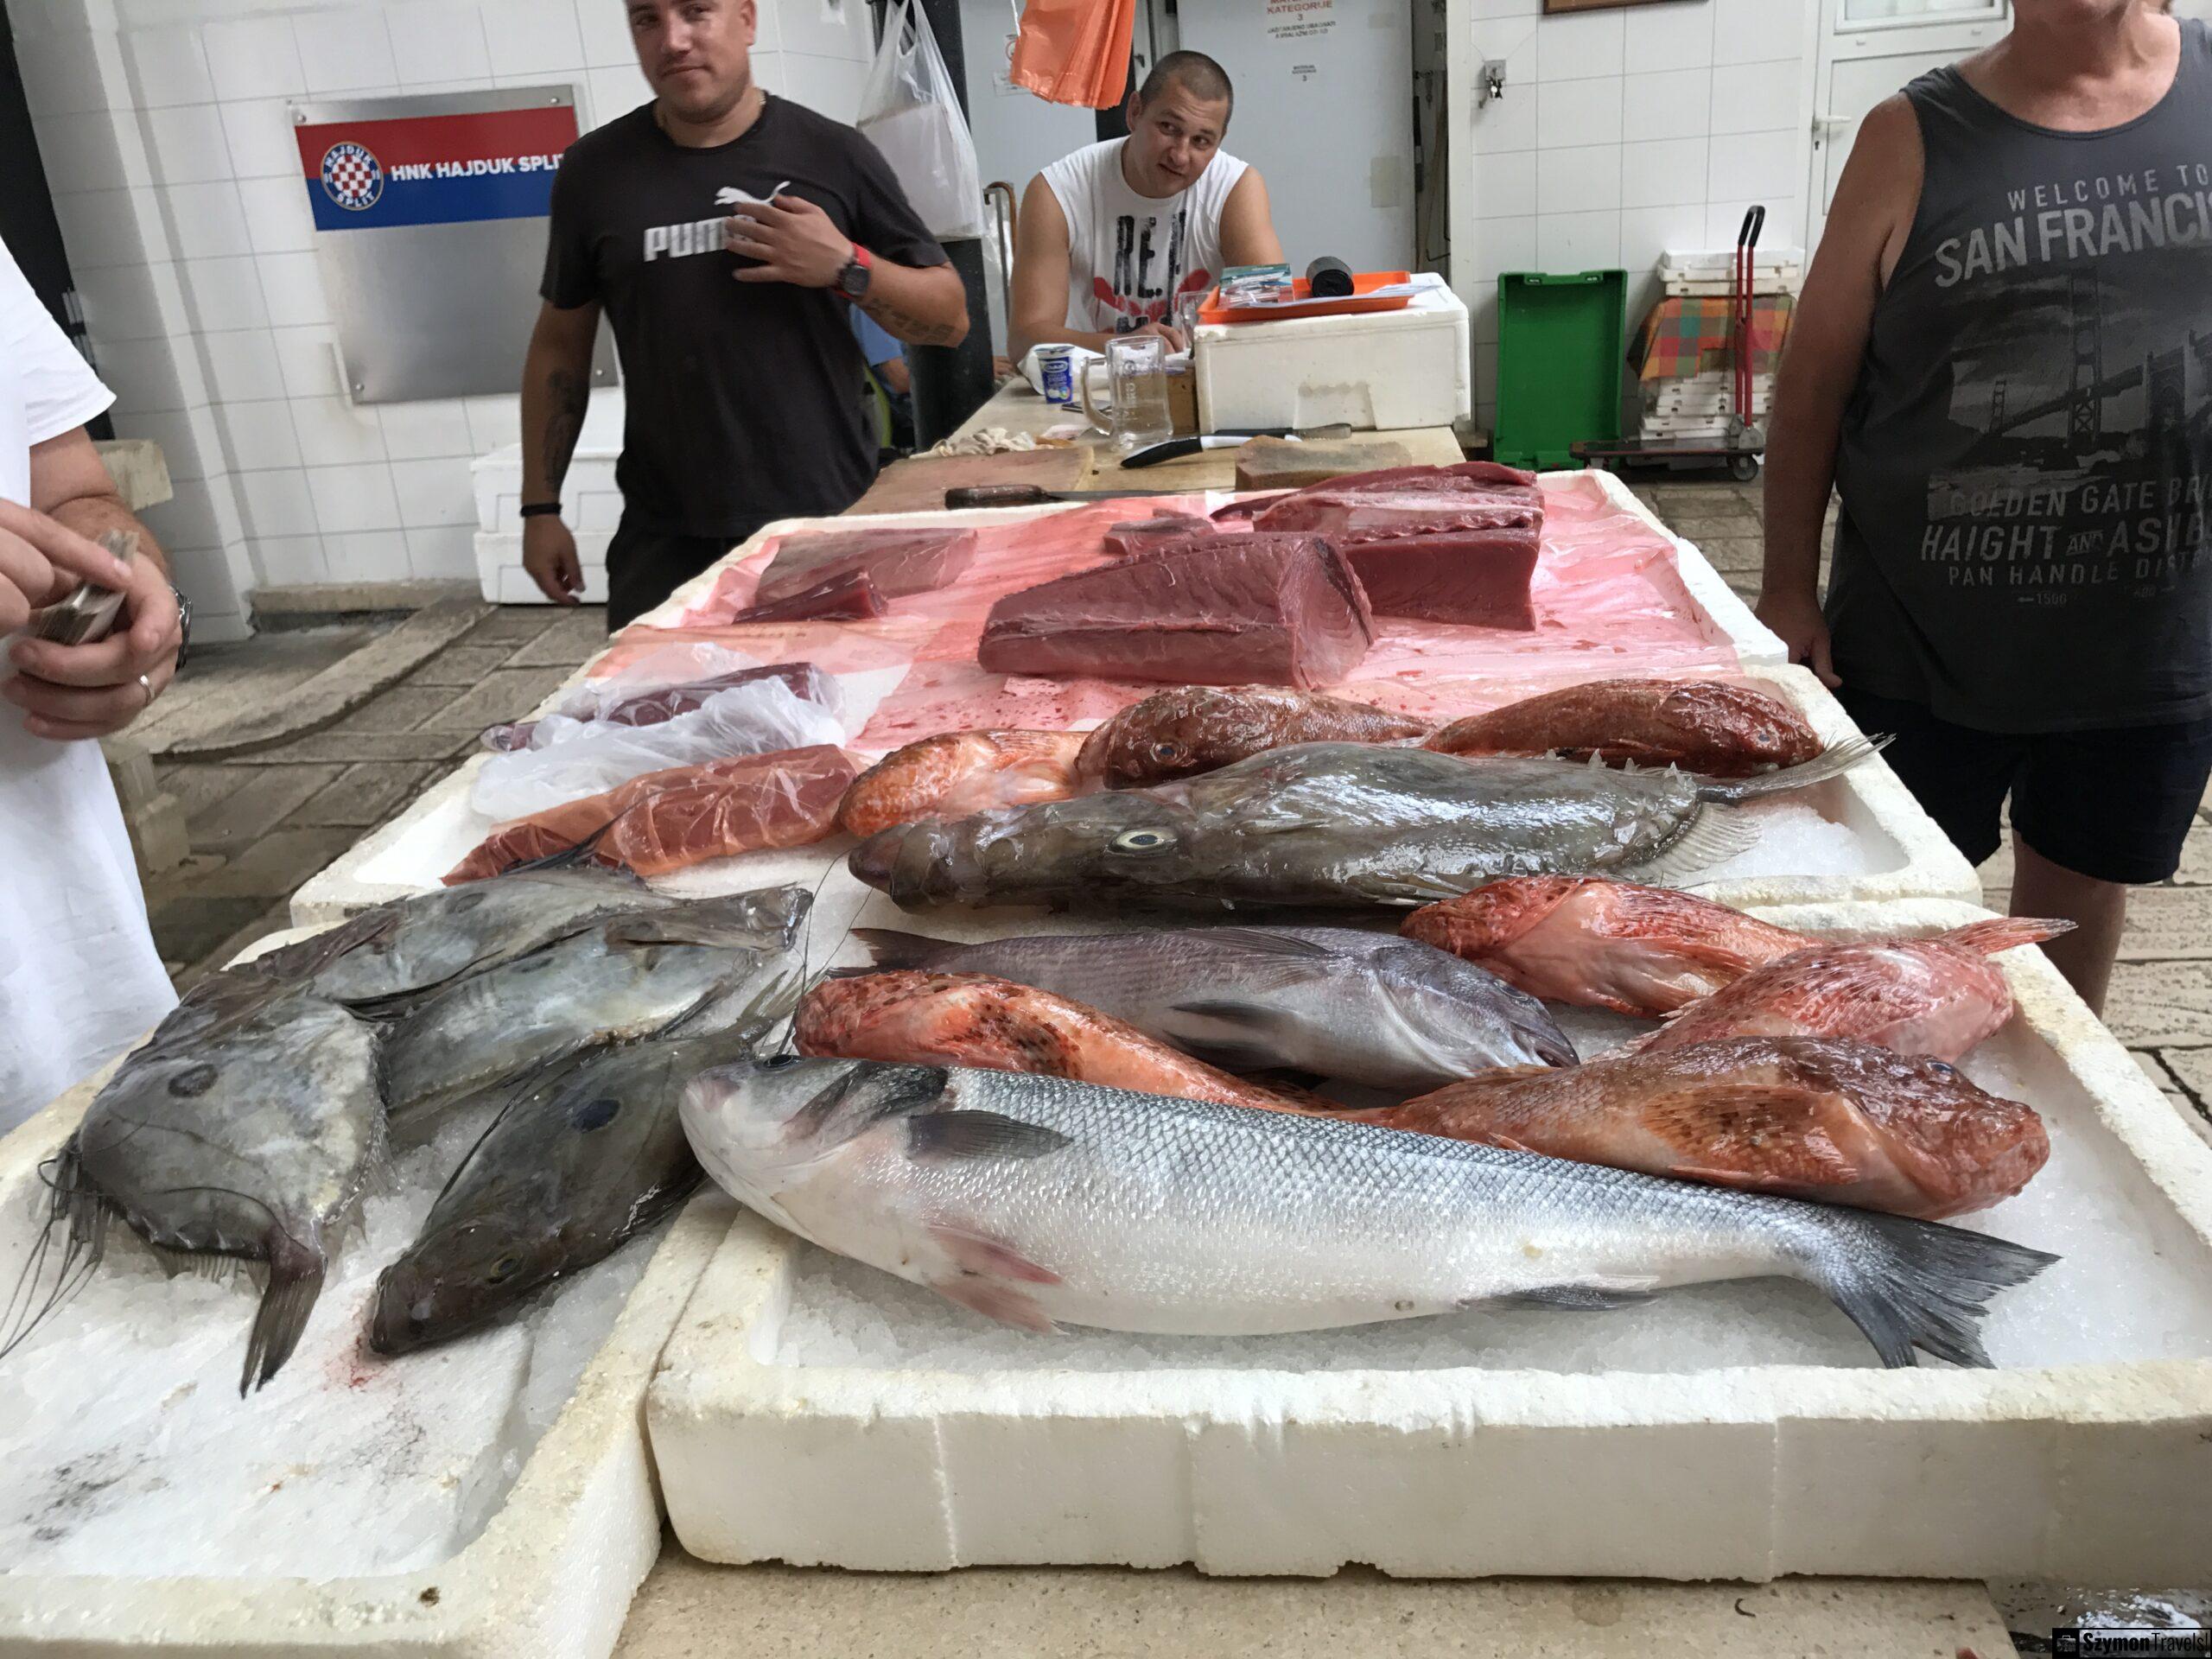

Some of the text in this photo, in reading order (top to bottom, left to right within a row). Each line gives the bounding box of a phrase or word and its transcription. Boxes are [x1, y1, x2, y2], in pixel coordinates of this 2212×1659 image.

[325, 144, 372, 168] HAJDUK
[390, 162, 434, 181] HNK
[435, 157, 515, 178] HAJDUK
[337, 191, 374, 207] SPLIT
[2008, 163, 2209, 213] WELCOME TO
[1935, 190, 2212, 288] SAN FRANCI
[1949, 487, 2067, 518] GOLDEN
[2081, 480, 2157, 514] GATE
[1921, 524, 2062, 562] HAIGHT
[1948, 566, 1993, 587] PAN
[2010, 563, 2119, 586] HANDLE
